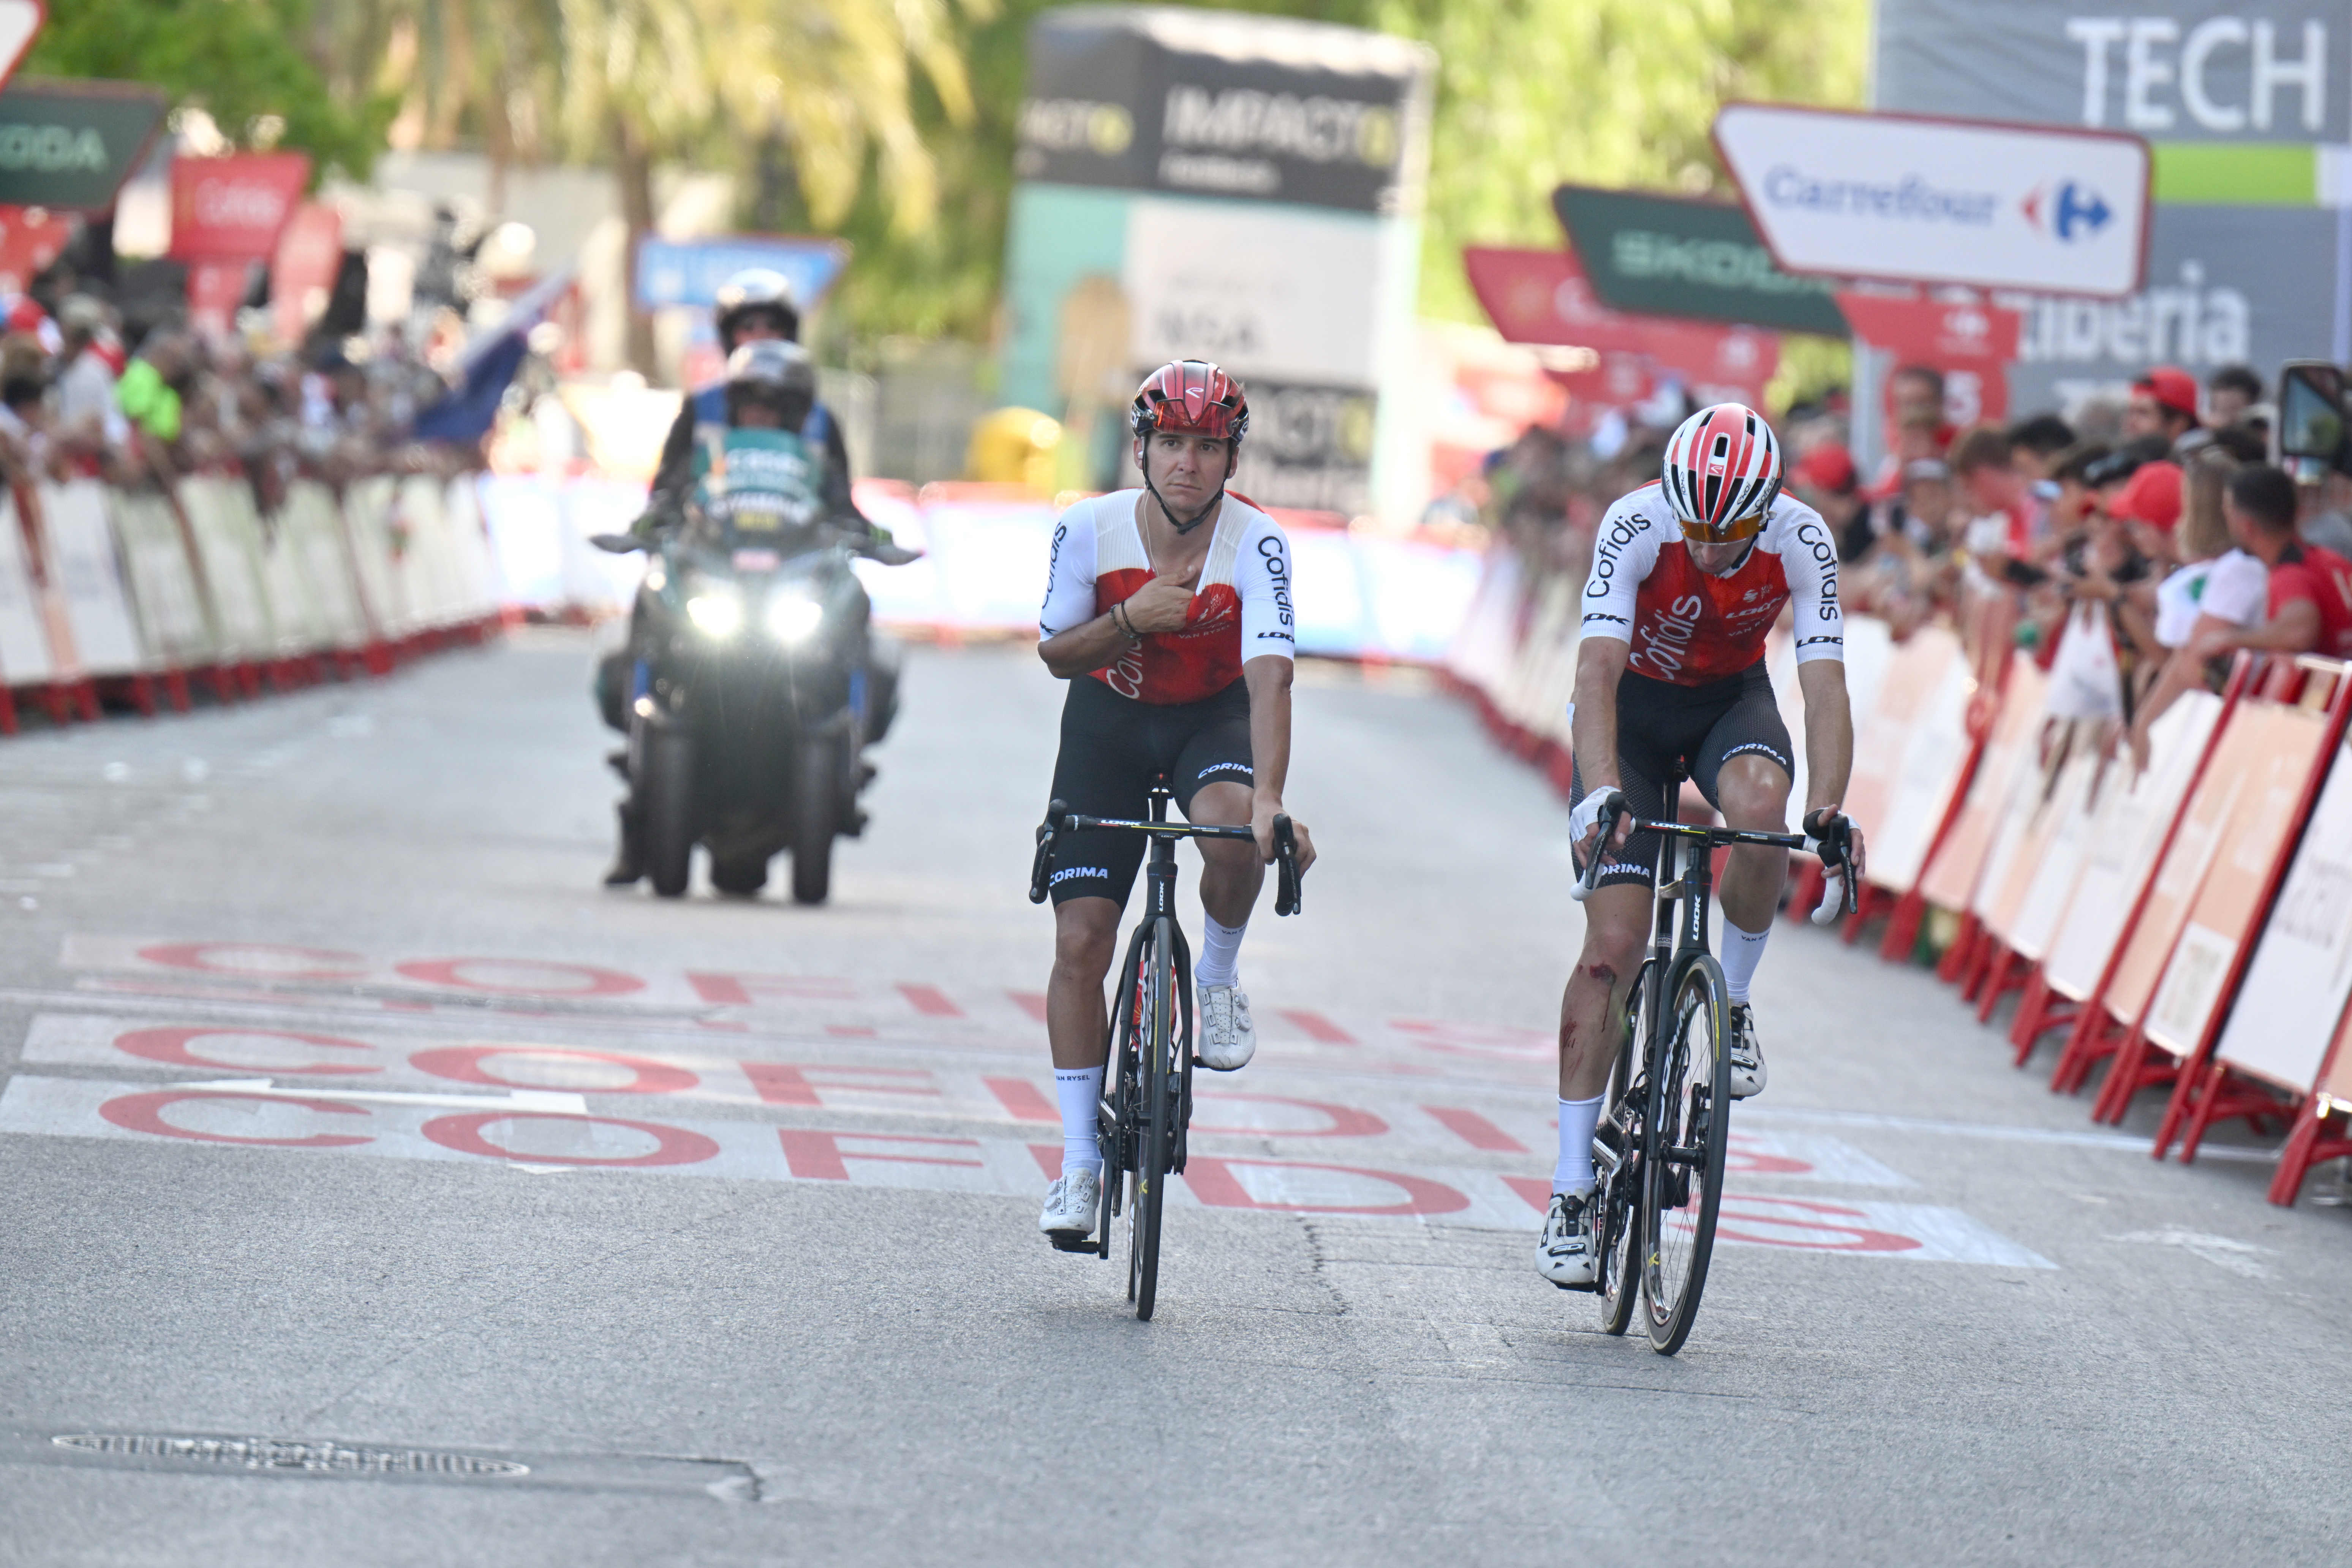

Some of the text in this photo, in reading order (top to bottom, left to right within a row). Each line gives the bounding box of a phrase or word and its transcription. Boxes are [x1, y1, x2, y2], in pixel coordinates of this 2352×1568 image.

[2064, 16, 2327, 131] TECH
[1586, 513, 1651, 598] Cofidis
[1258, 536, 1293, 626] Cofidis
[1797, 524, 1839, 621] Cofidis
[1581, 613, 1631, 628] OOK
[1257, 632, 1295, 643] LOO
[1797, 636, 1843, 648] LOO
[1722, 743, 1787, 765] CORIMA
[1198, 762, 1254, 779] CORIM
[1651, 822, 1691, 830] LOOK
[1049, 866, 1108, 887] CORIMA
[1601, 863, 1650, 879] ORIMA
[1693, 894, 1701, 941] LOOK
